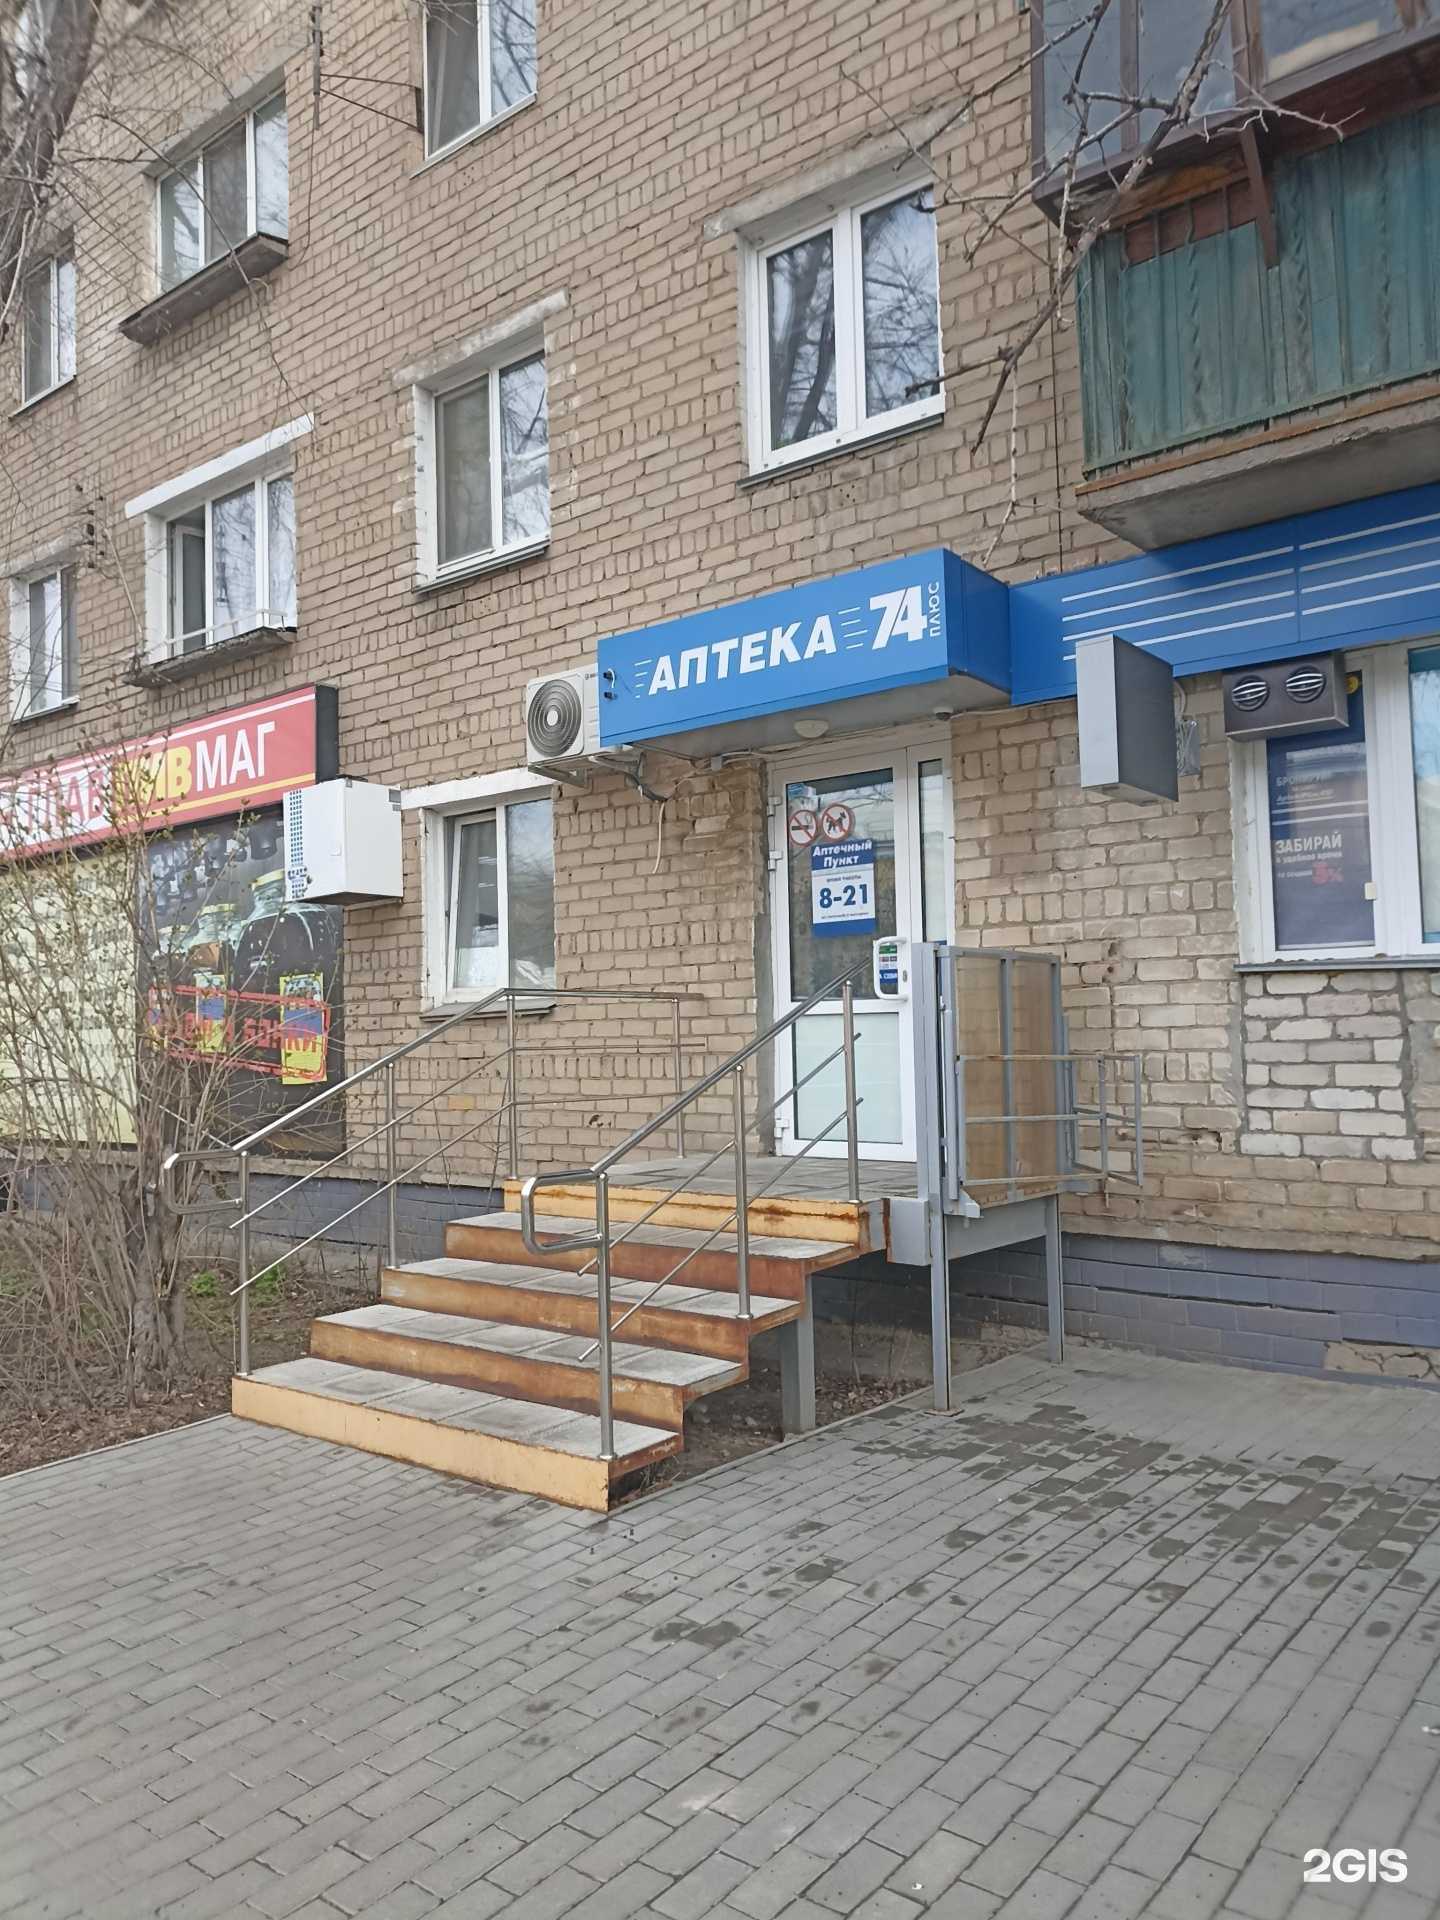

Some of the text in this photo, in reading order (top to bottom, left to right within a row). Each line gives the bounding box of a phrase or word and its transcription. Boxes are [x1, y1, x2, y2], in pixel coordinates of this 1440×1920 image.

[648, 581, 941, 696] АПТЕКА 74 ПЛЮС
[812, 840, 873, 857] Аптечный
[1275, 830, 1342, 854] ЗАБИРАЙ
[823, 855, 860, 869] Пункт
[819, 883, 869, 909] 8-21
